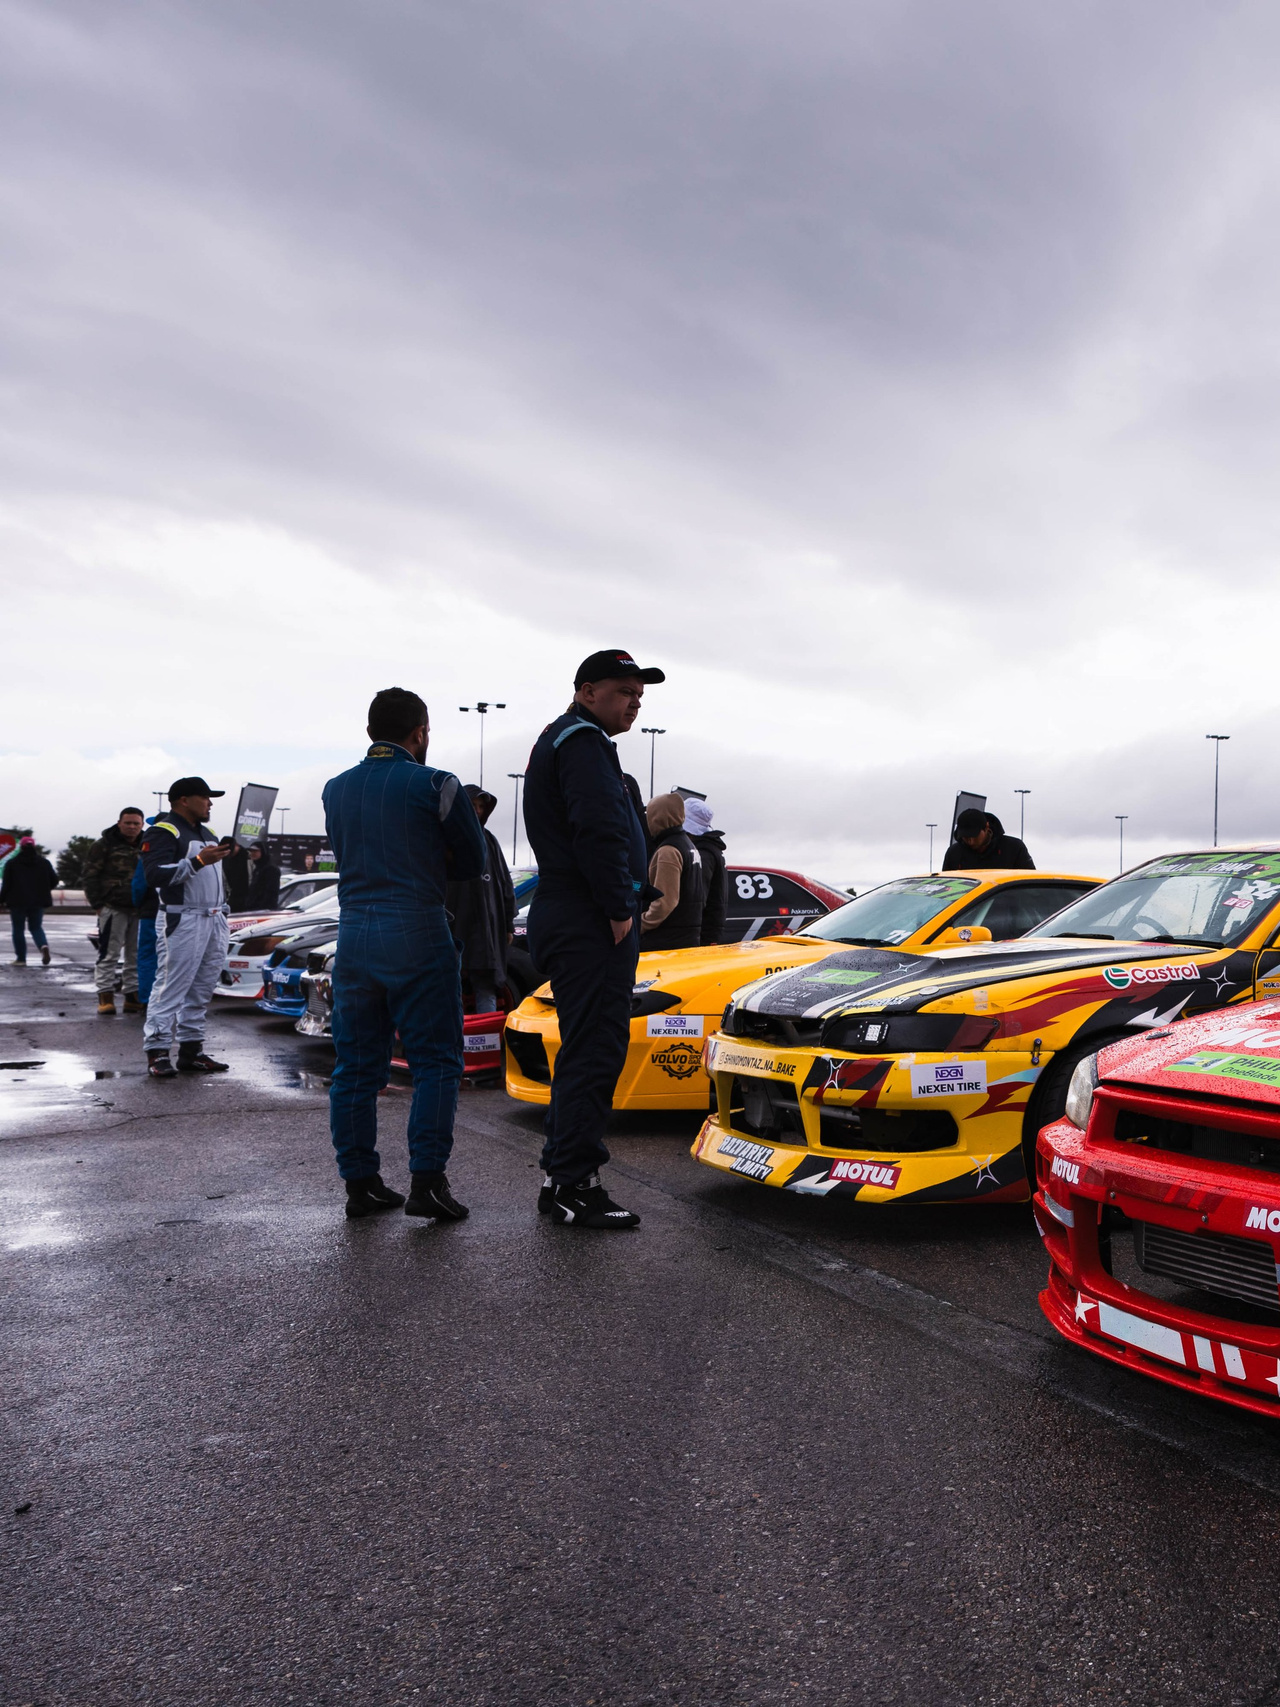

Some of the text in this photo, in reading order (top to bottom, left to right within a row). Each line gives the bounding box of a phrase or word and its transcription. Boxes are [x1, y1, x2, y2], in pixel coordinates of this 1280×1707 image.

[735, 874, 774, 899] 83
[1131, 963, 1200, 982] Castrol
[680, 1028, 699, 1036] TIRE
[650, 1053, 688, 1065] VOLVO
[935, 1067, 964, 1080] NEXEN
[1220, 1066, 1279, 1083] OneBlade
[918, 1081, 982, 1095] NEXEN TIRE
[731, 1158, 773, 1181] ALMATY
[831, 1161, 895, 1187] MOTUL
[1051, 1154, 1080, 1185] MOTUL
